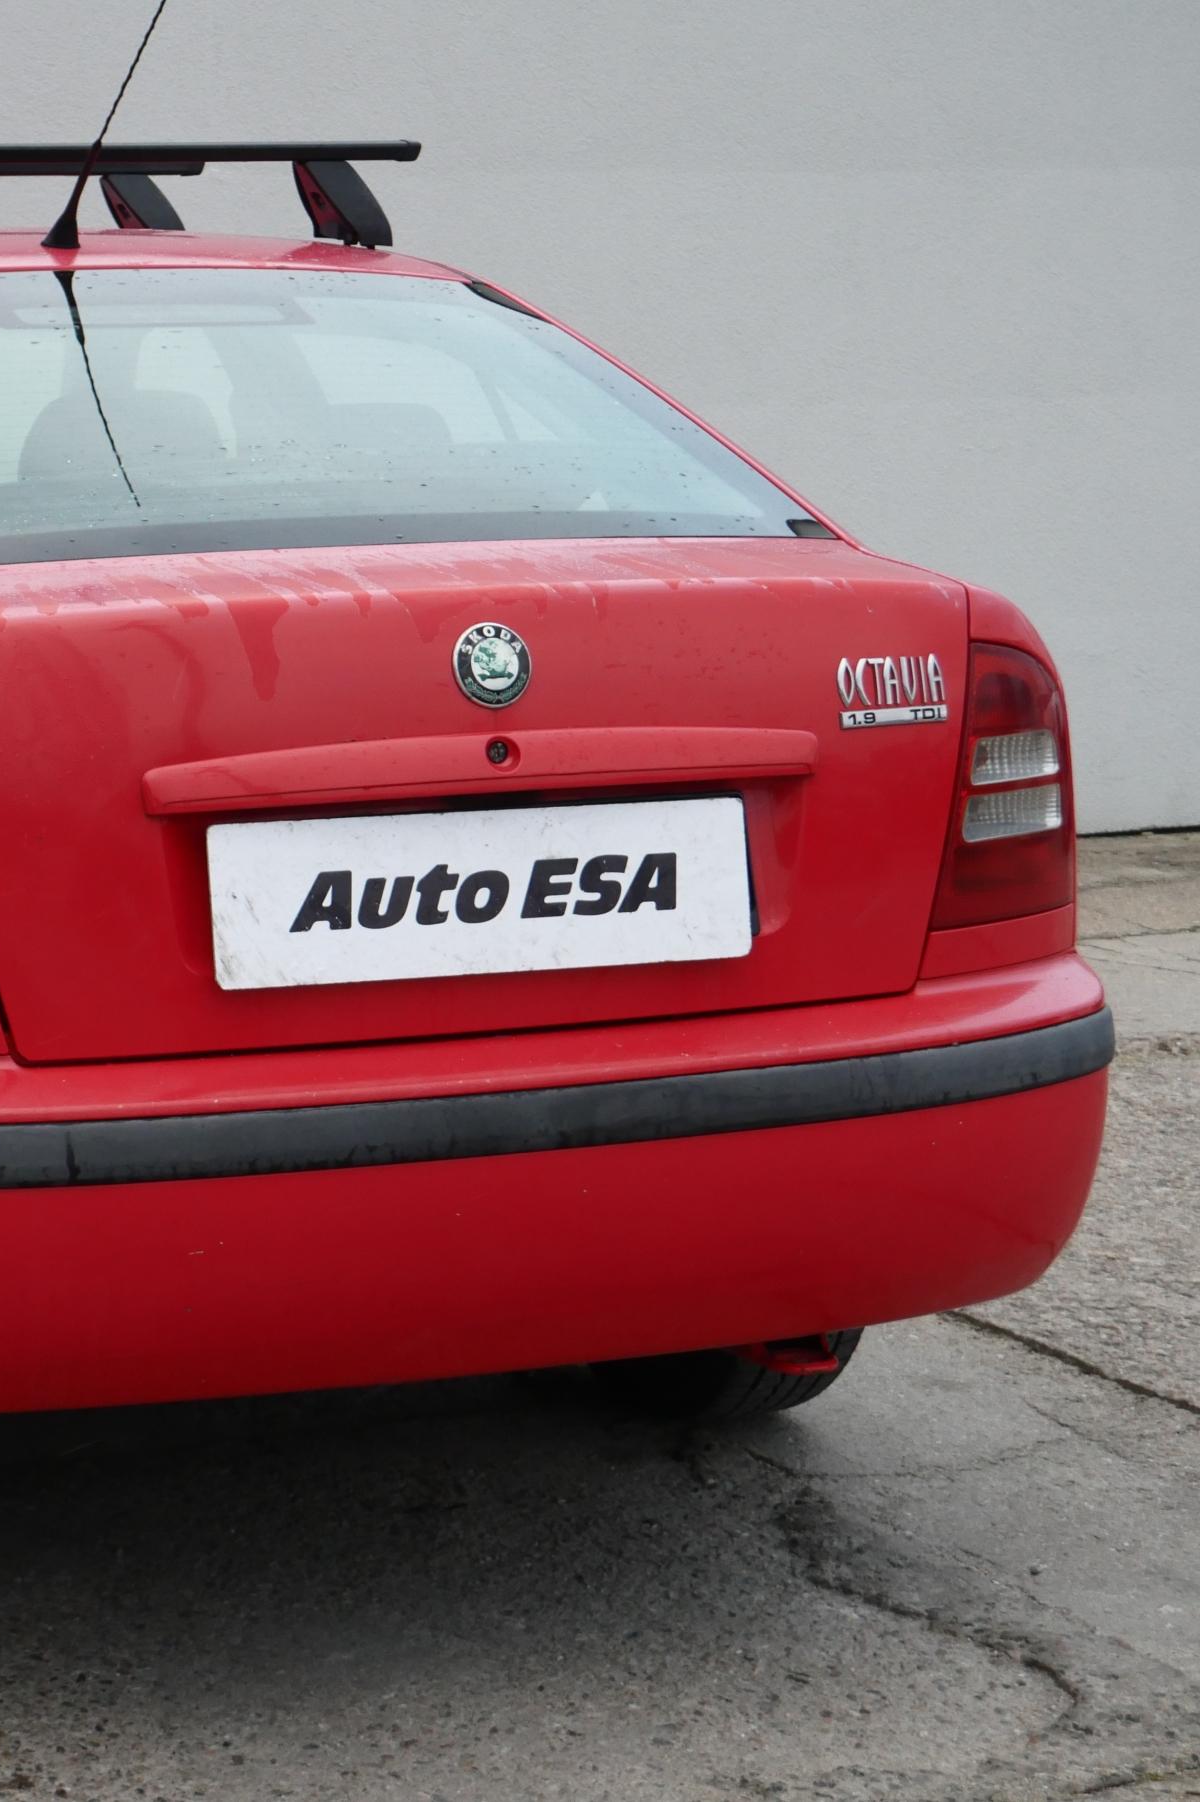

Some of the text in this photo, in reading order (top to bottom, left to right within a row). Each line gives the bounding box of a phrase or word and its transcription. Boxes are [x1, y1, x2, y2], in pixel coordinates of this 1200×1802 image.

[837, 653, 945, 707] OCTAVIA
[848, 707, 945, 725] 1.9 TDI
[289, 852, 677, 933] Auto ESA
